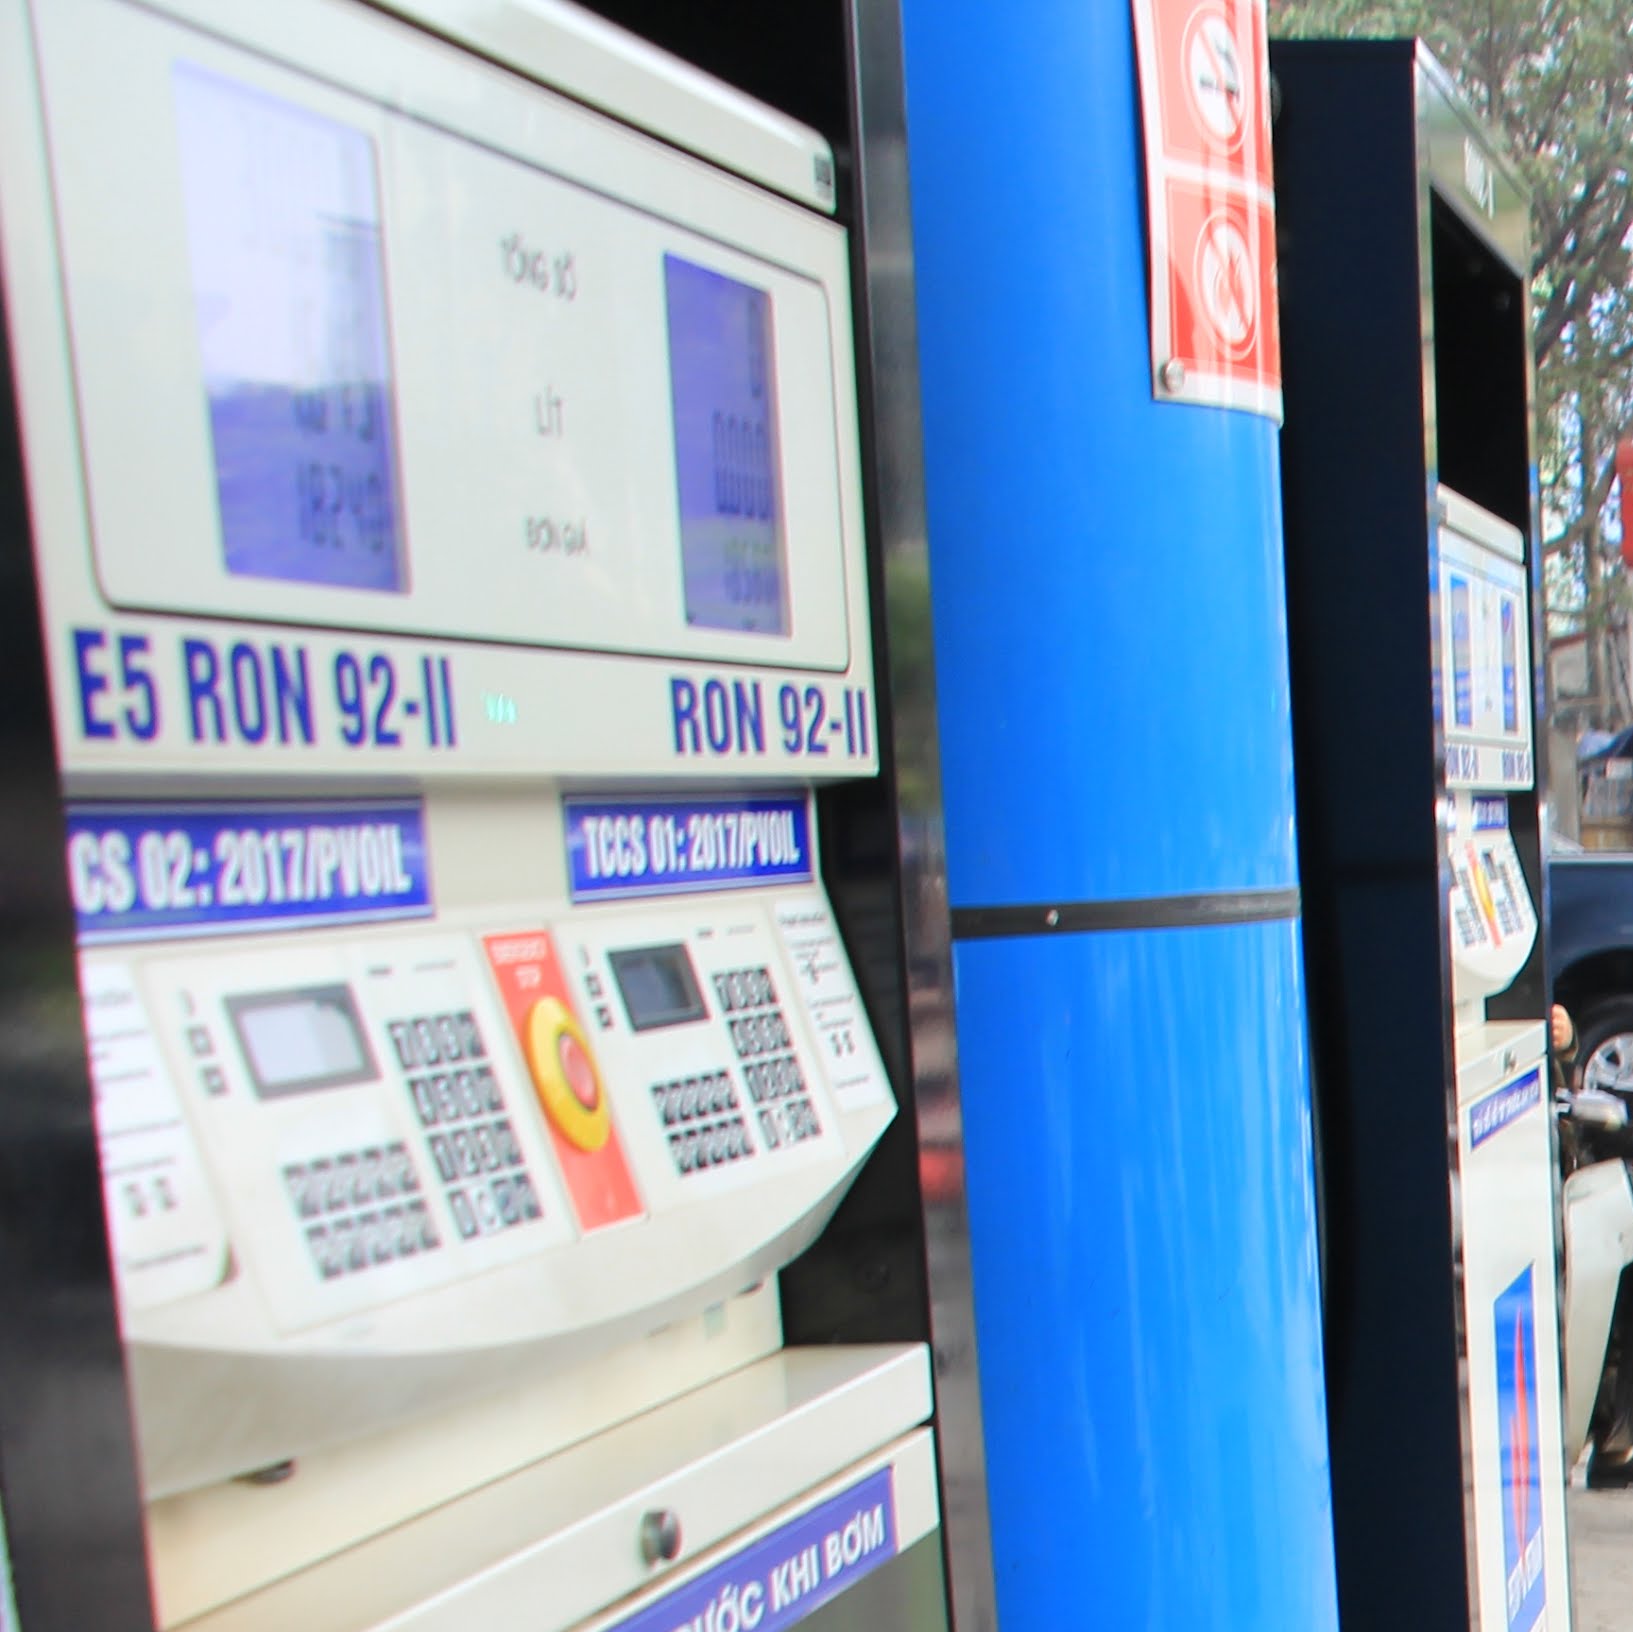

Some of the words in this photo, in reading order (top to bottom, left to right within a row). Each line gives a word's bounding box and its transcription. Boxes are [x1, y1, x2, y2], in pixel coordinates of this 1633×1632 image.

[72, 629, 158, 740] E5
[183, 638, 316, 744] RON
[336, 652, 456, 748] 92-II
[671, 677, 766, 755] RON
[780, 686, 869, 756] 92-II
[139, 832, 212, 909] 02:
[215, 824, 412, 905] 2017/PVOIL
[583, 816, 647, 879] TCCS
[650, 816, 685, 873] 01:
[691, 812, 799, 871] 2017/PVOIL
[771, 1547, 819, 1613] KHI
[826, 1503, 885, 1573] BƠM
